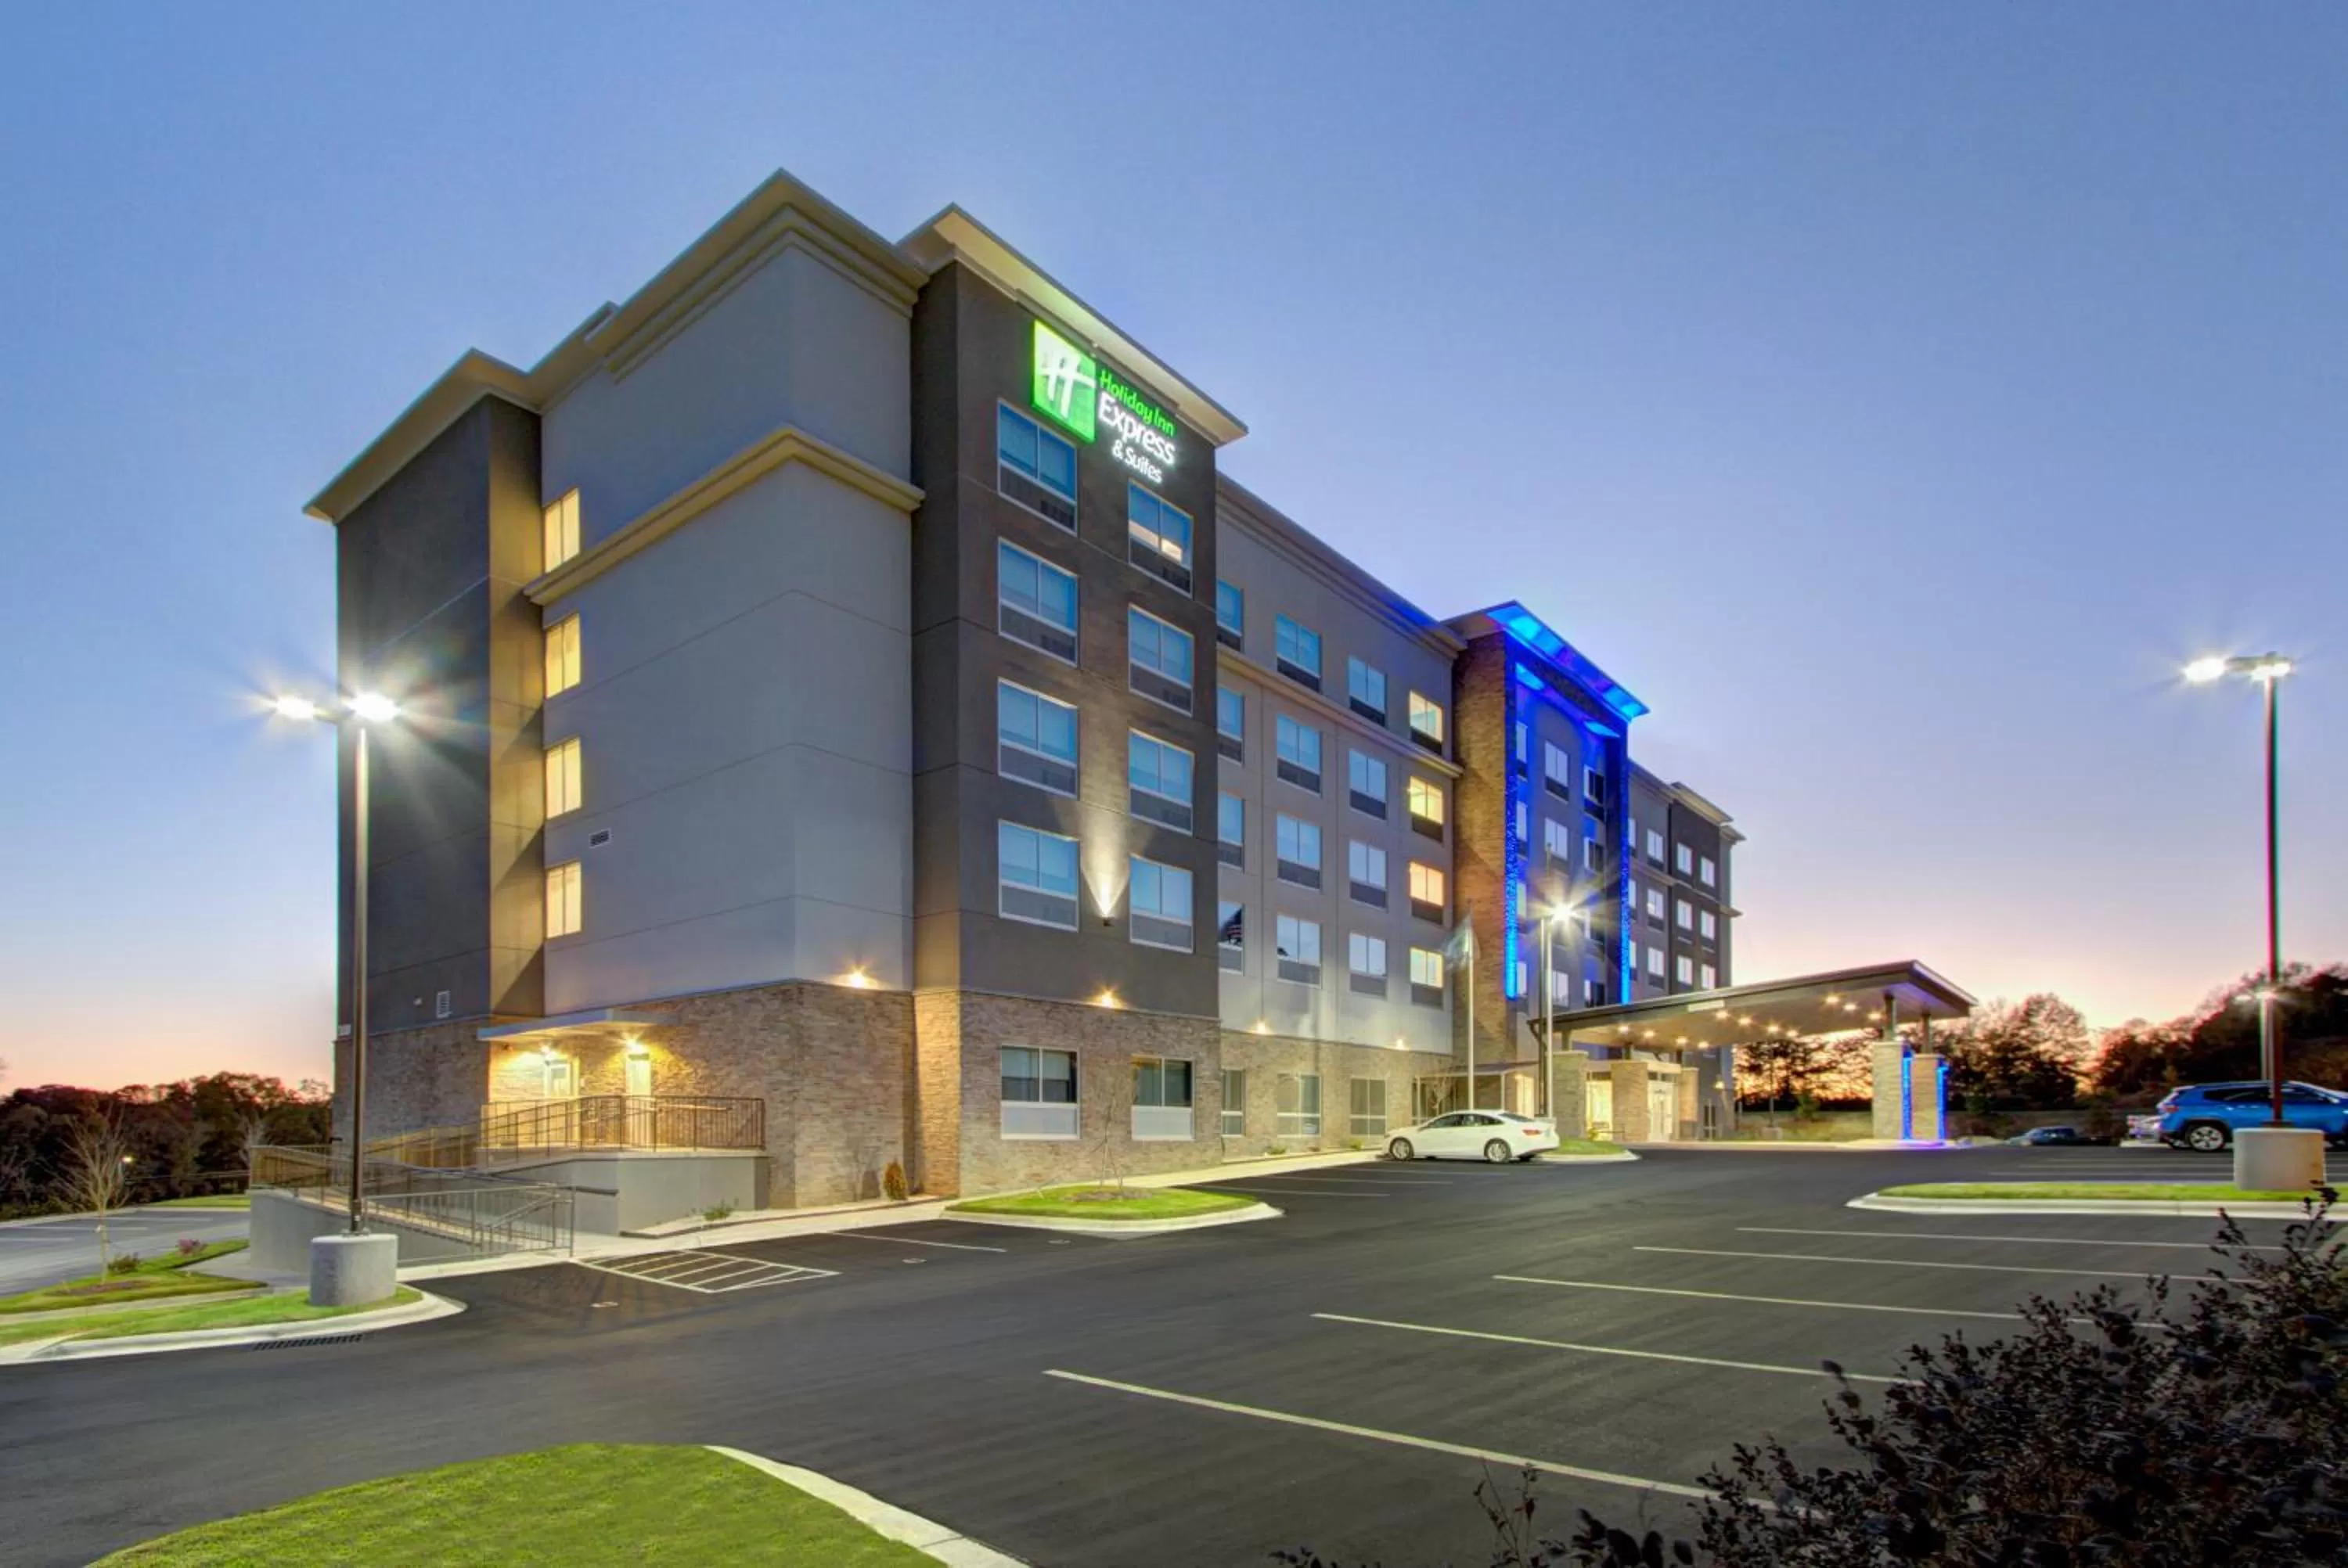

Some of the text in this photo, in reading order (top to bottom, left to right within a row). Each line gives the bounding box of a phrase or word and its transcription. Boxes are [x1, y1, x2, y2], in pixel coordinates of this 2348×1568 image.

[1098, 391, 1176, 465] Express
[1099, 369, 1175, 437] Holiday Inn
[1111, 440, 1162, 484] & Suites
